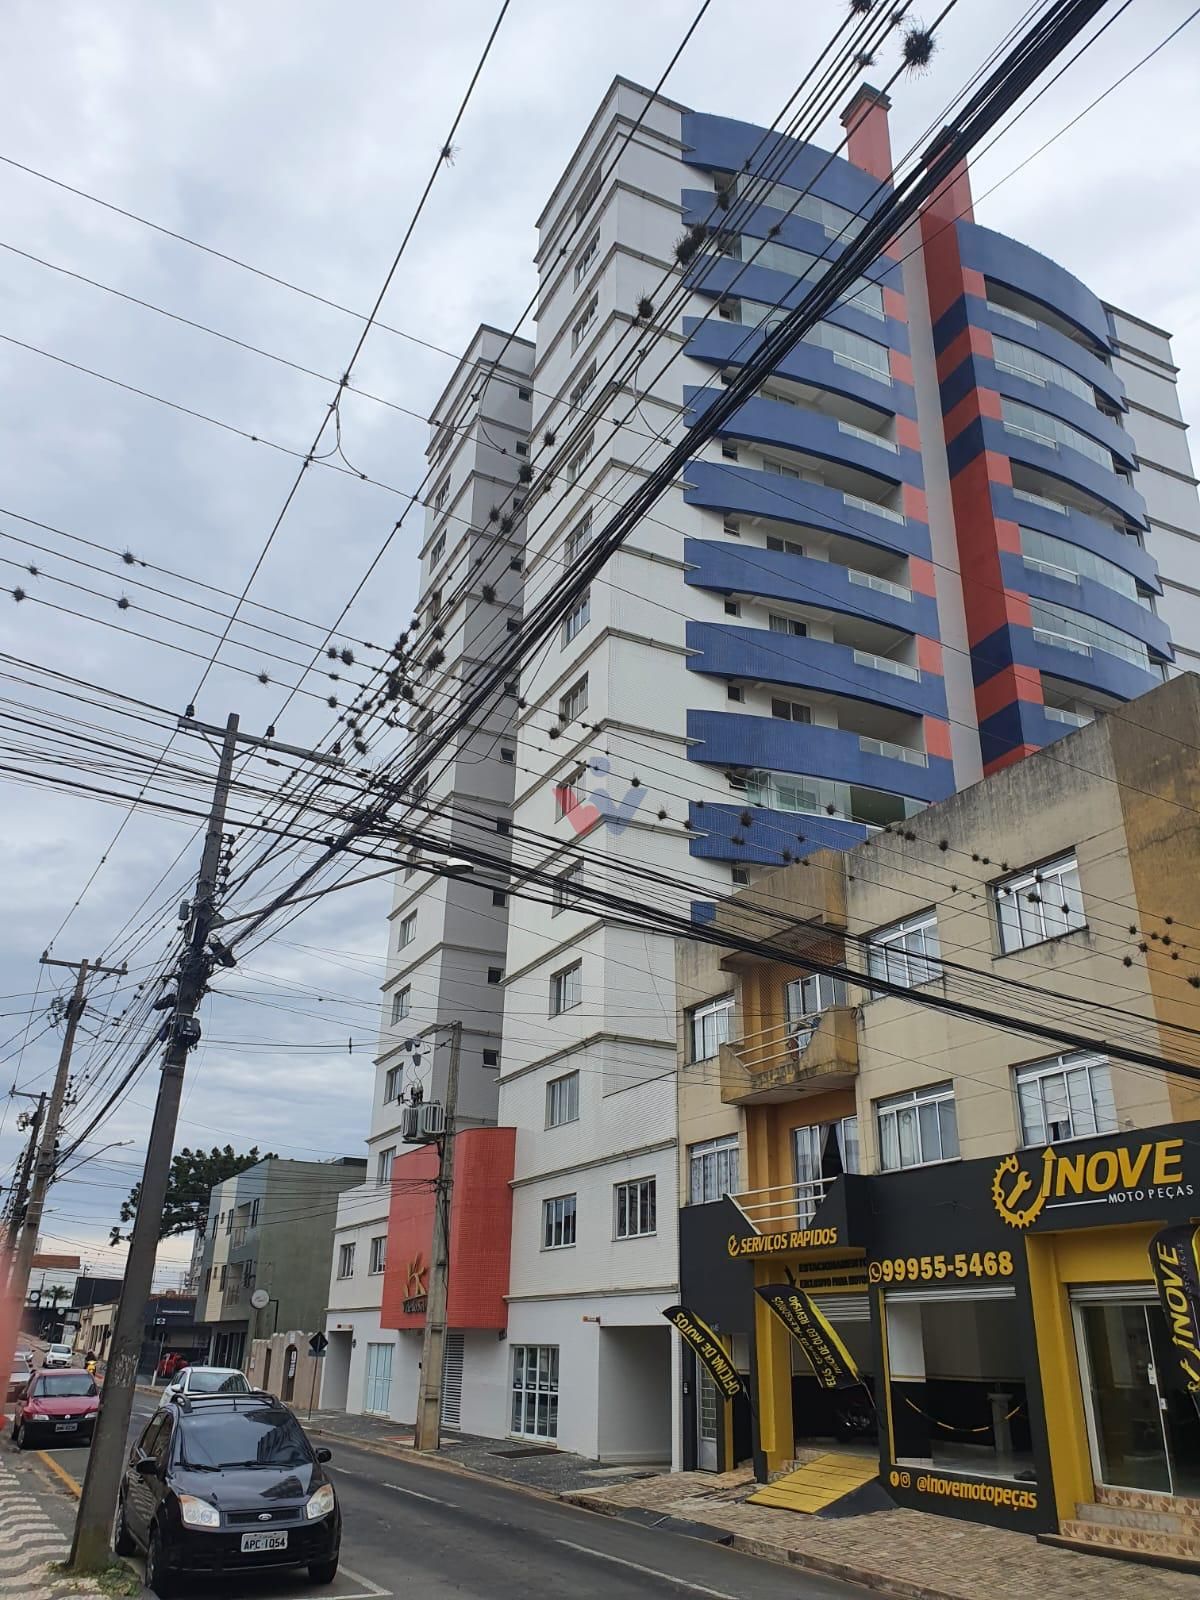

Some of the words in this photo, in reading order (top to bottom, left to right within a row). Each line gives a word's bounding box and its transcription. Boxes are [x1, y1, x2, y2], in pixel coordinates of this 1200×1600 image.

[1041, 1139, 1184, 1198] INOVE
[1108, 1189, 1144, 1204] MOTO
[1148, 1184, 1194, 1199] PEÇAS
[740, 1232, 788, 1253] SERVIÇOS
[882, 1250, 1014, 1282] 99955-5468
[1156, 1241, 1195, 1350] INOVE
[701, 1342, 717, 1358] DE
[711, 1354, 740, 1395] OFICINA
[917, 1474, 1038, 1511] @inovemotopeças
